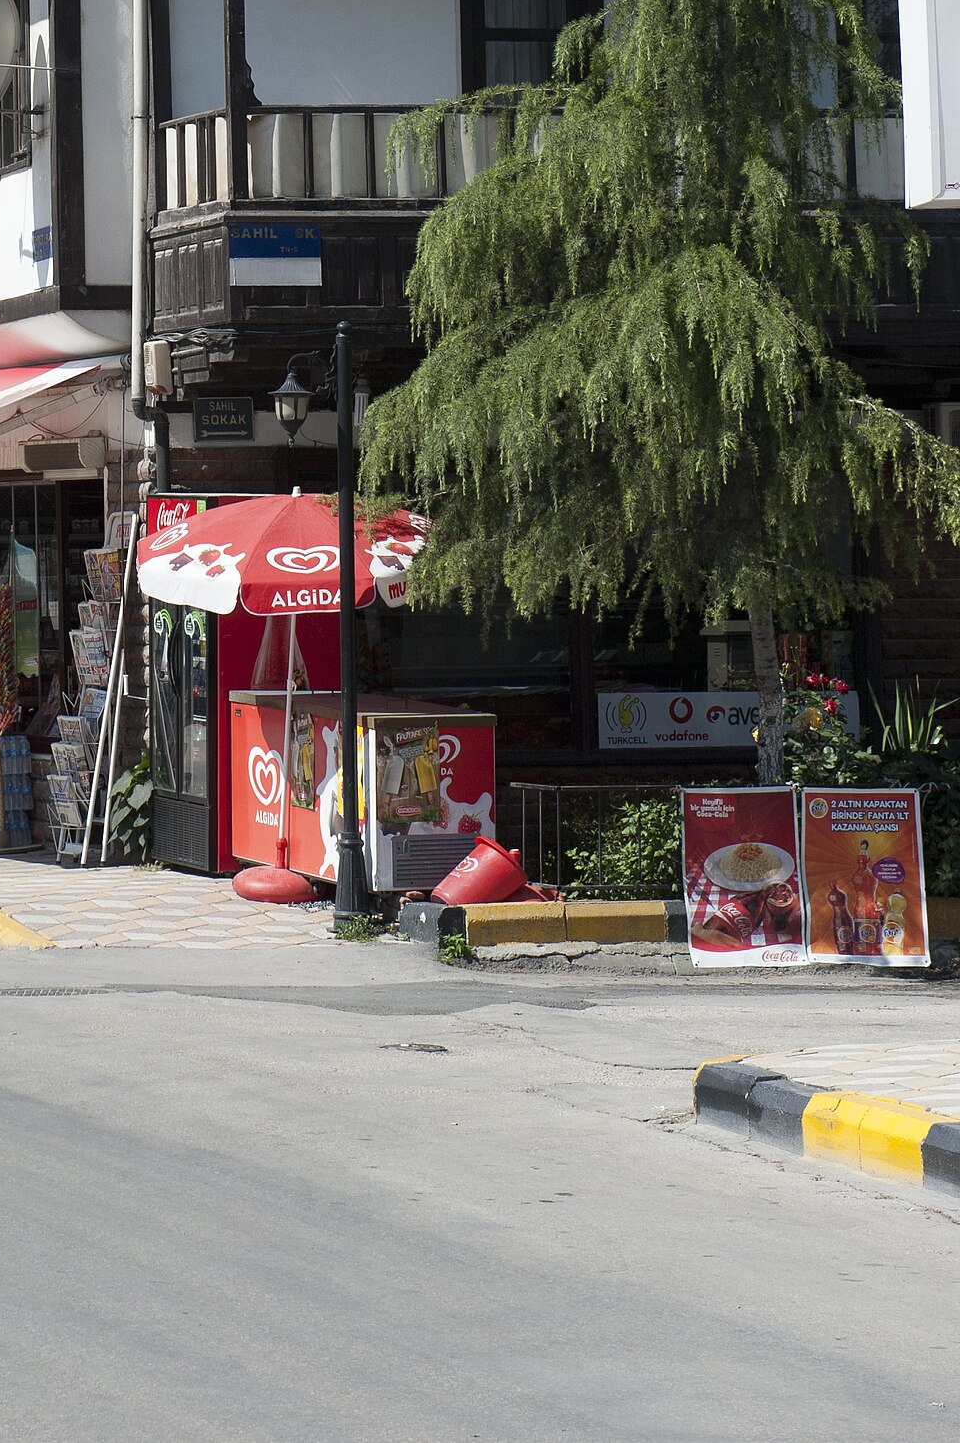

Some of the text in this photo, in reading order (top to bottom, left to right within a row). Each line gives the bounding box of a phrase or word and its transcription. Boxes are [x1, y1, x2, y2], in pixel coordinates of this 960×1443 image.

[201, 414, 246, 425] SOKAK
[607, 736, 648, 745] TURKCELL
[655, 729, 709, 742] vodafone
[831, 800, 908, 809] 2 ALTIN KAPAKTAN
[867, 811, 896, 820] FANTA
[831, 823, 899, 834] KAZANMA ŞANSI
